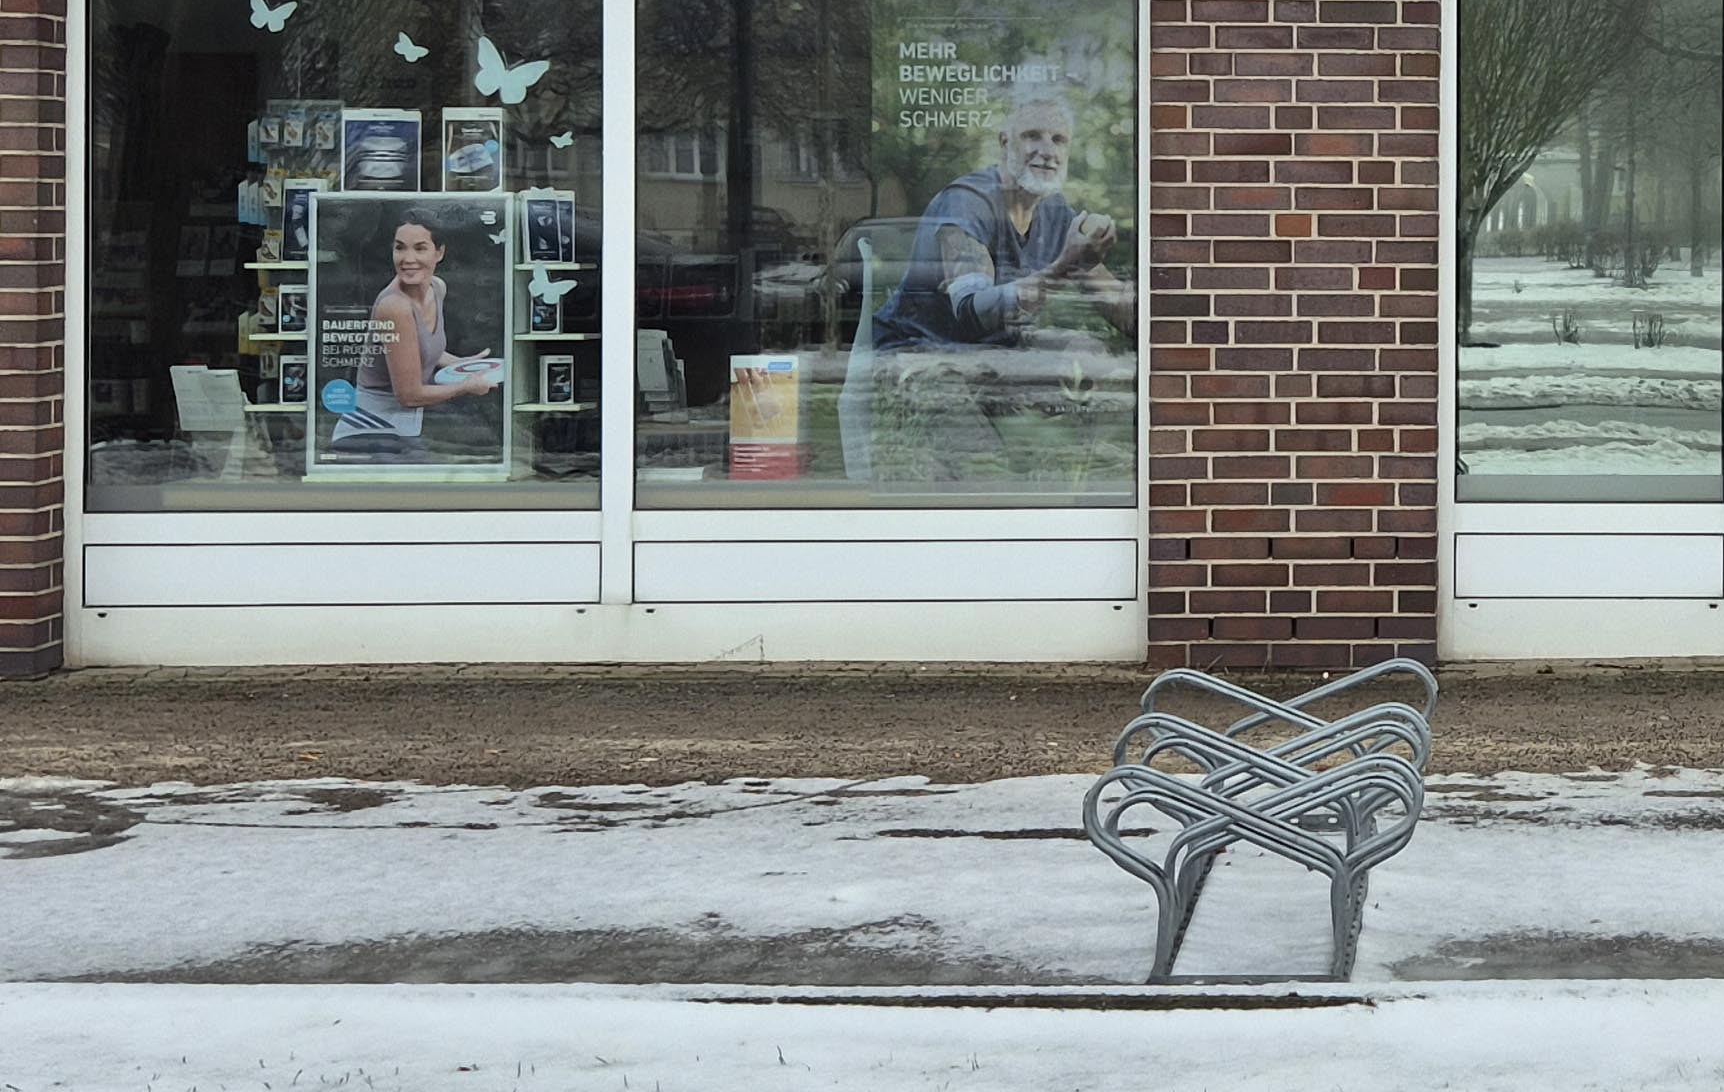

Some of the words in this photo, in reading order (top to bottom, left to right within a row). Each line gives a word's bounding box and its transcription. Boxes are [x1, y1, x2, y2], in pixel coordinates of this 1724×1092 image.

[899, 42, 957, 59] MEHR
[899, 65, 1059, 82] BEWEGLICHKEIT
[899, 88, 988, 105] WENIGER
[899, 110, 992, 128] SCHMERZ
[322, 320, 395, 330] BAUERFEIND
[322, 333, 370, 342] BEWEGT
[372, 333, 400, 342] DICH
[322, 358, 375, 367] SCHMERZ
